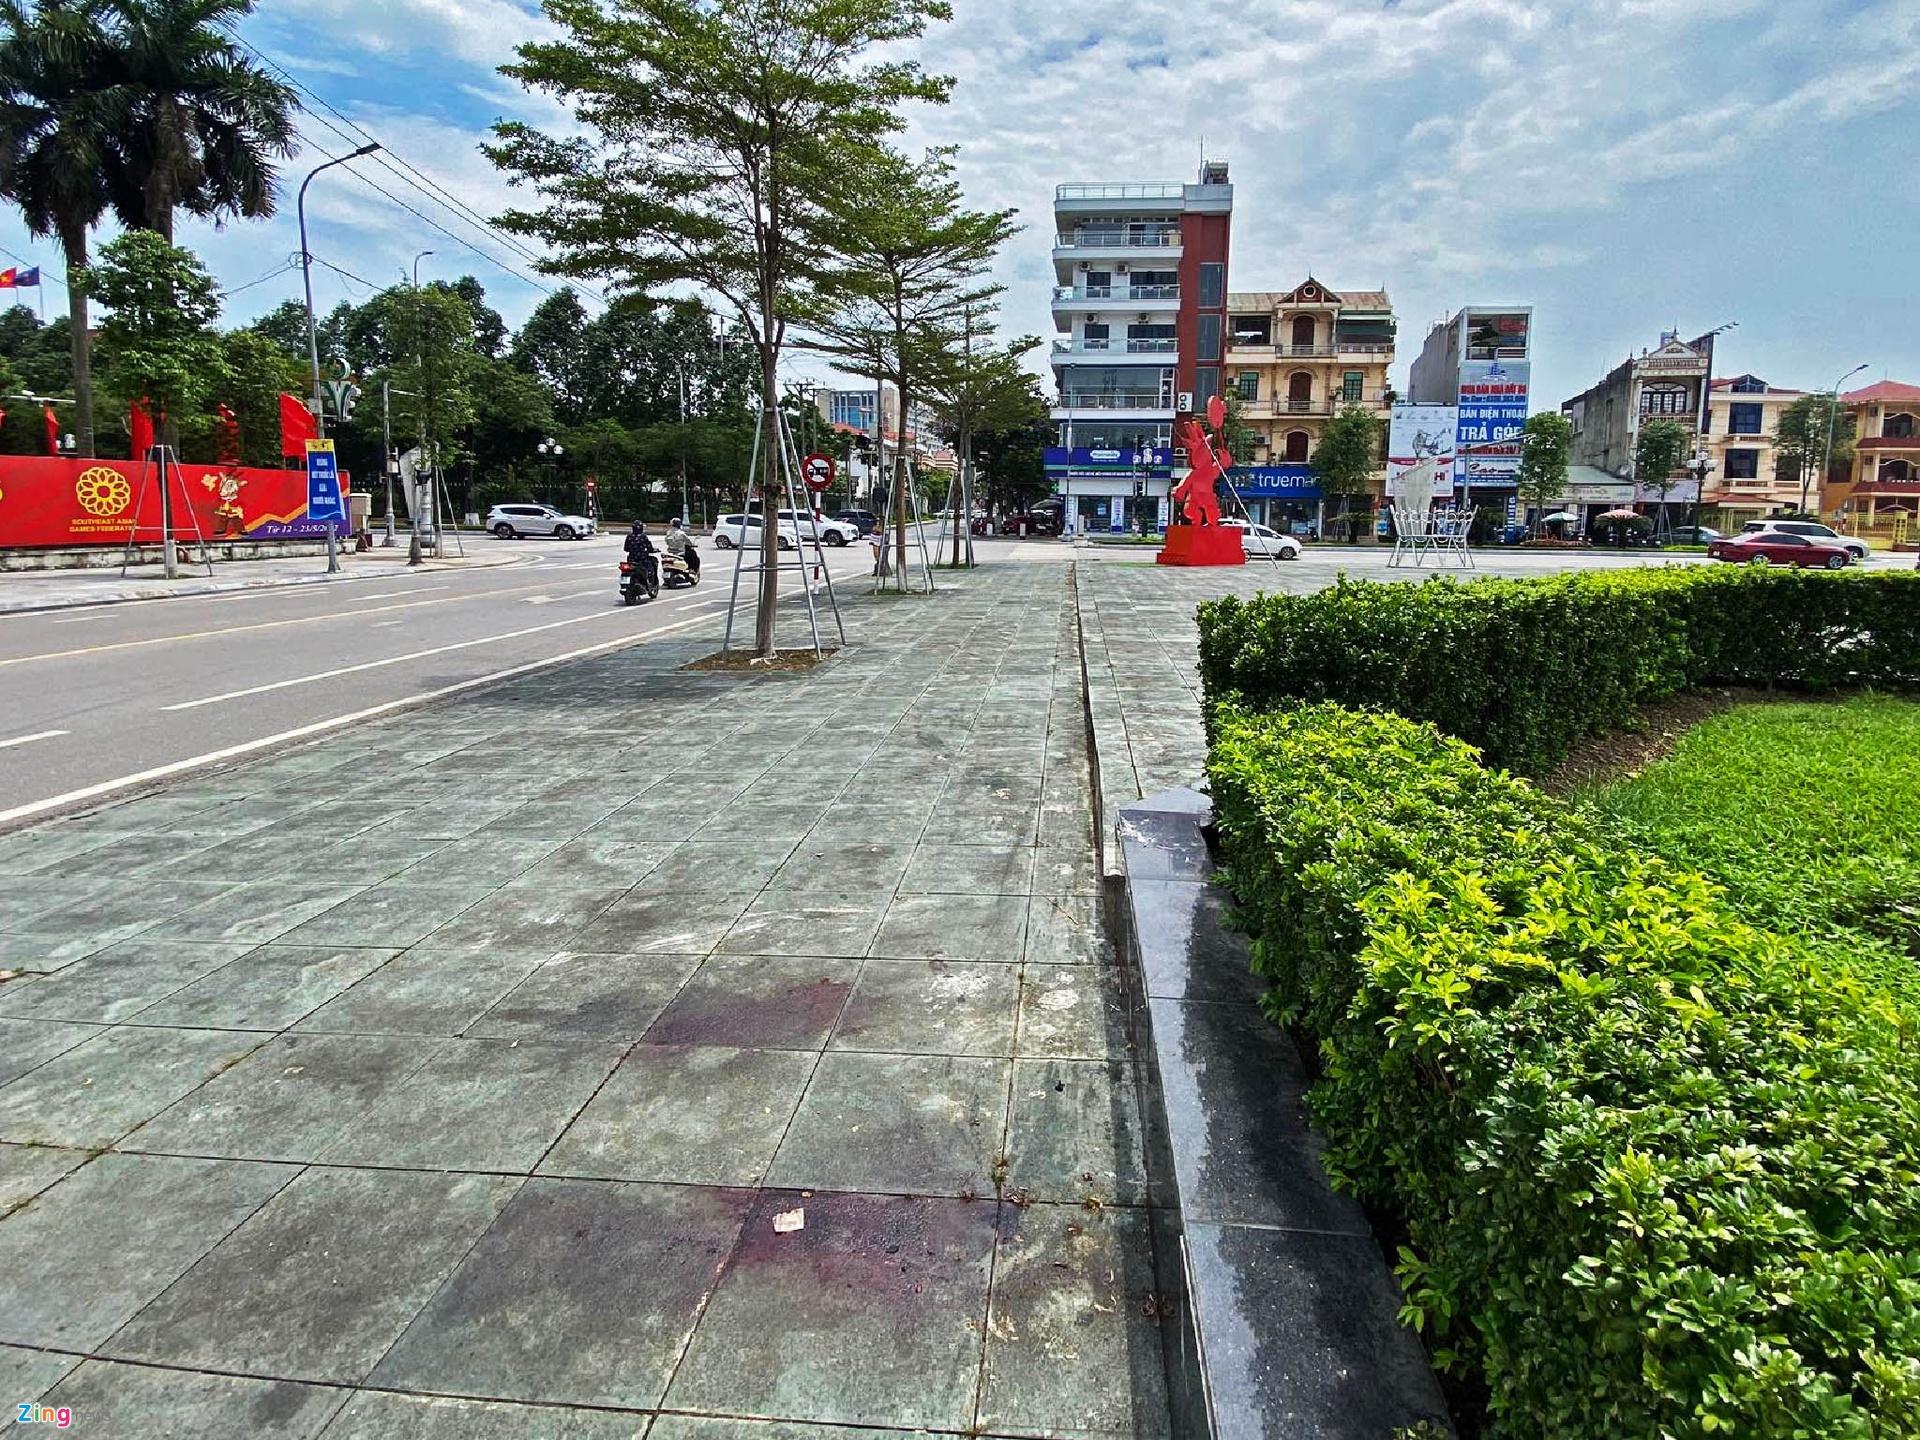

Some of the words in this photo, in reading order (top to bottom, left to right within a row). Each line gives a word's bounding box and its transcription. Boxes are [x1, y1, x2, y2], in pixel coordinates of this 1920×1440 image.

[1460, 407, 1478, 418] BÁN
[1480, 407, 1499, 421] ĐIỆN
[1502, 409, 1526, 421] THOẠI
[1460, 421, 1488, 440] TRẢ
[69, 525, 95, 533] GAMES
[282, 525, 293, 533] 12
